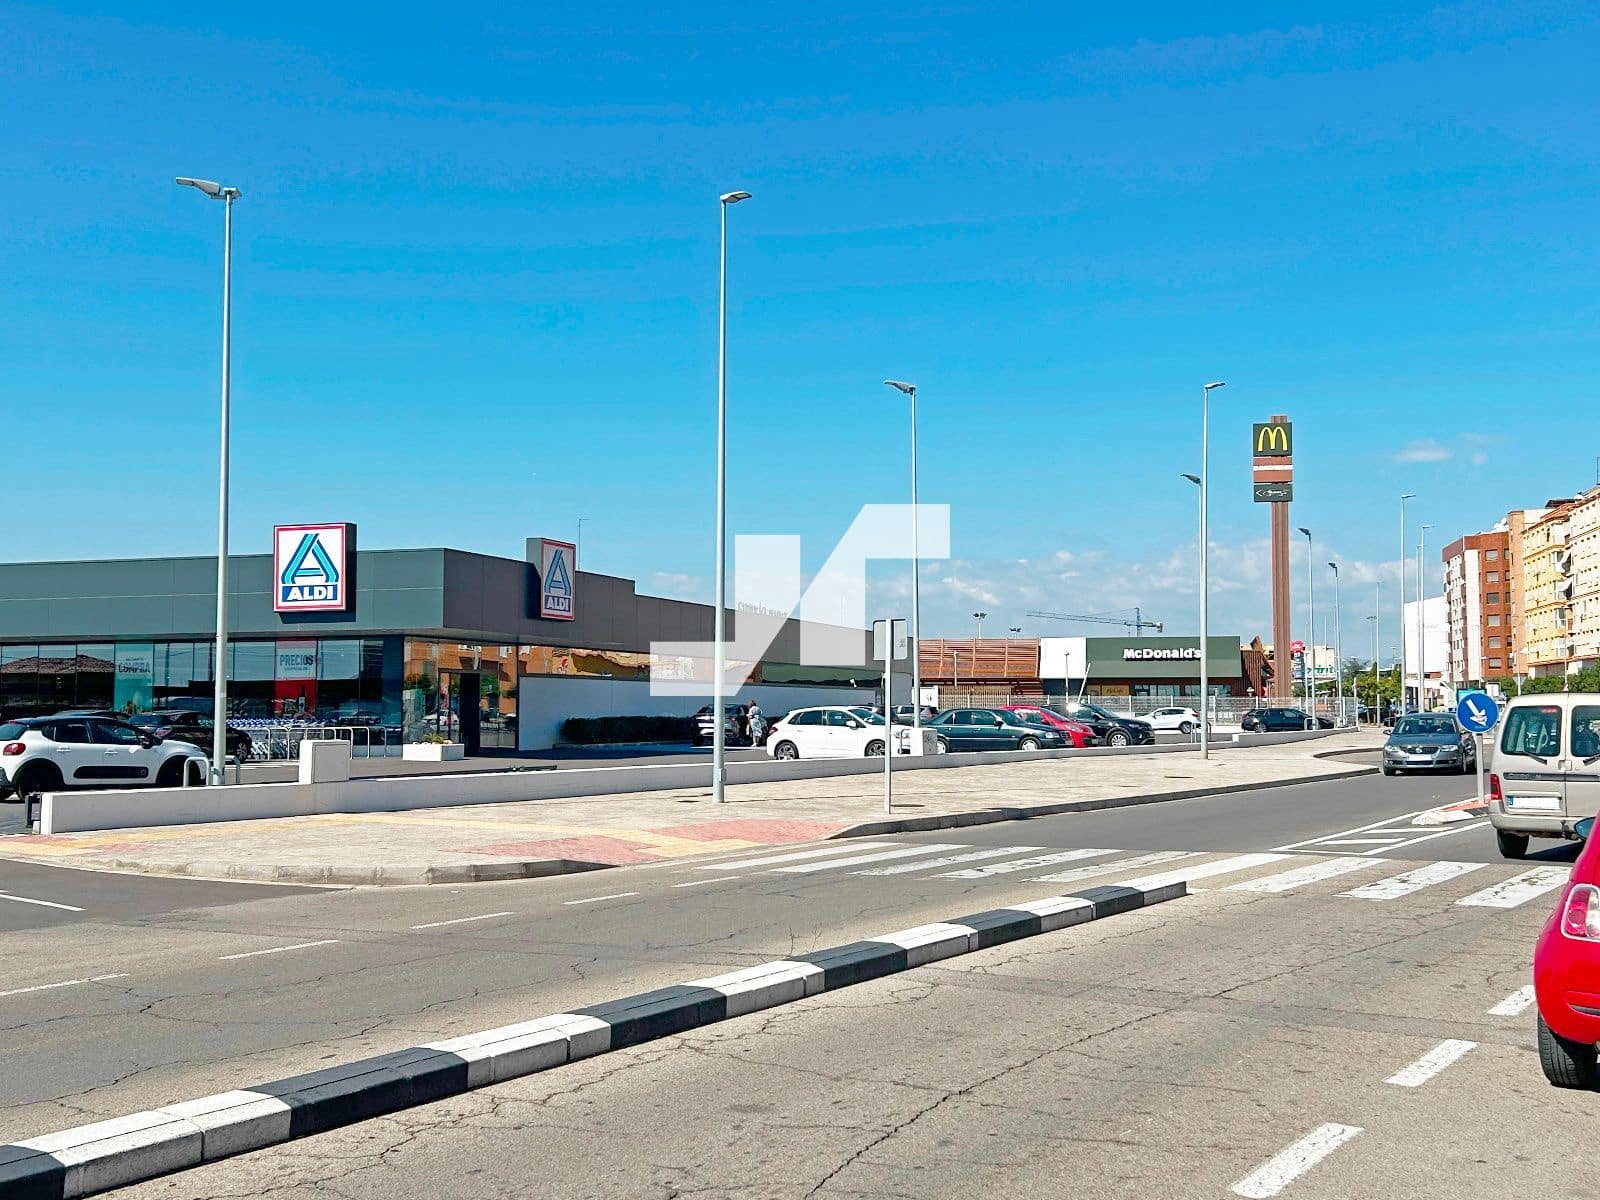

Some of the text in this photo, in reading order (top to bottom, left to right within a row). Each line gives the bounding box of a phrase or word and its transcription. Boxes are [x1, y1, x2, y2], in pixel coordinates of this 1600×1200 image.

[287, 586, 334, 600] ALDI
[546, 596, 569, 612] ALDI
[279, 654, 314, 666] PRECIOS
[1123, 648, 1202, 659] McDonald's
